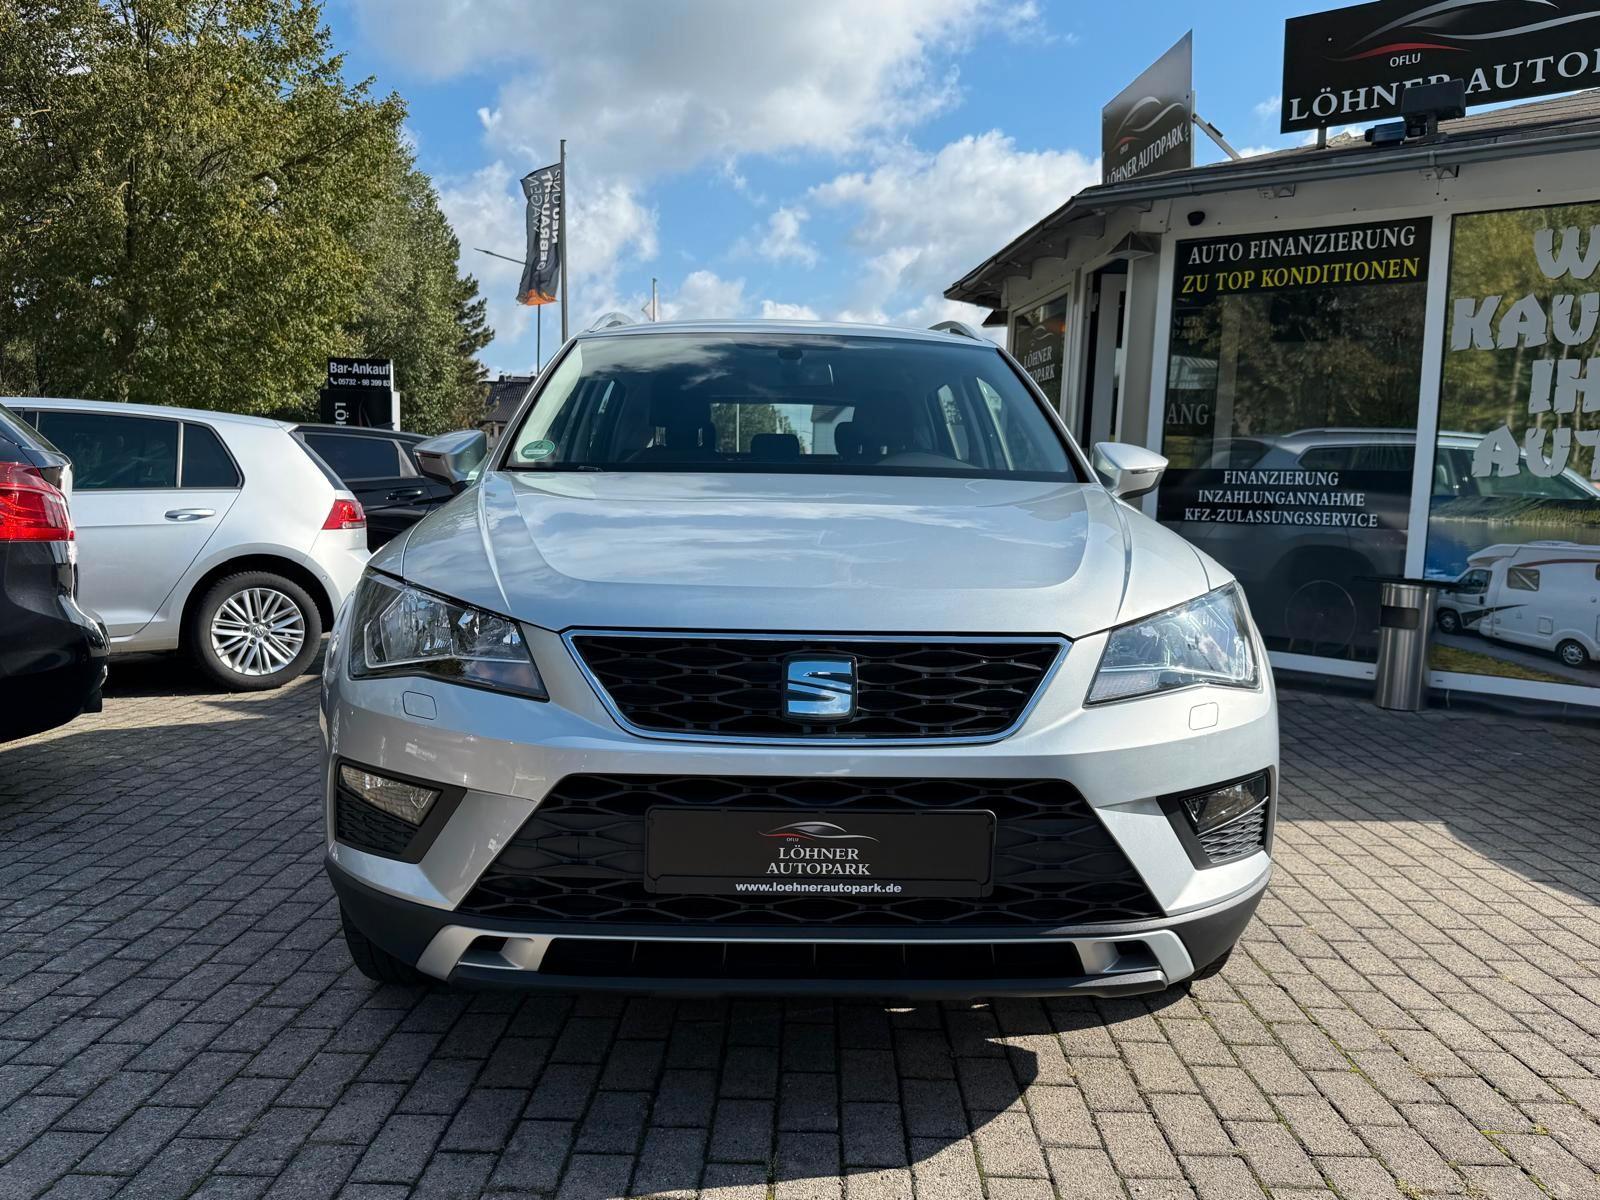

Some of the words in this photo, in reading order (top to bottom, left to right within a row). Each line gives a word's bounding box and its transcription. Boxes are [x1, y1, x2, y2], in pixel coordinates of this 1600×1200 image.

[1389, 52, 1421, 67] OFLU
[1288, 74, 1450, 121] LÖHN
[1138, 122, 1184, 172] AUTOPARK
[1188, 242, 1243, 265] AUTO
[1248, 225, 1416, 260] FINANZIERUNG
[1181, 274, 1209, 294] ZU
[1215, 270, 1255, 291] TOP
[1260, 257, 1420, 288] KONDITIONEN
[329, 362, 391, 375] Bar-Ankauf
[1028, 363, 1056, 383] OPARK
[1223, 470, 1340, 486] FINANZIERUNG
[1198, 489, 1365, 507] INZAHLUNGANNAHME
[1184, 508, 1378, 528] KFZ-ZULASSUNGSSERVICE
[778, 844, 859, 860] LÖHNER
[765, 862, 872, 876] AUTOPARK
[735, 882, 902, 895] www.loehnerautopark.de
